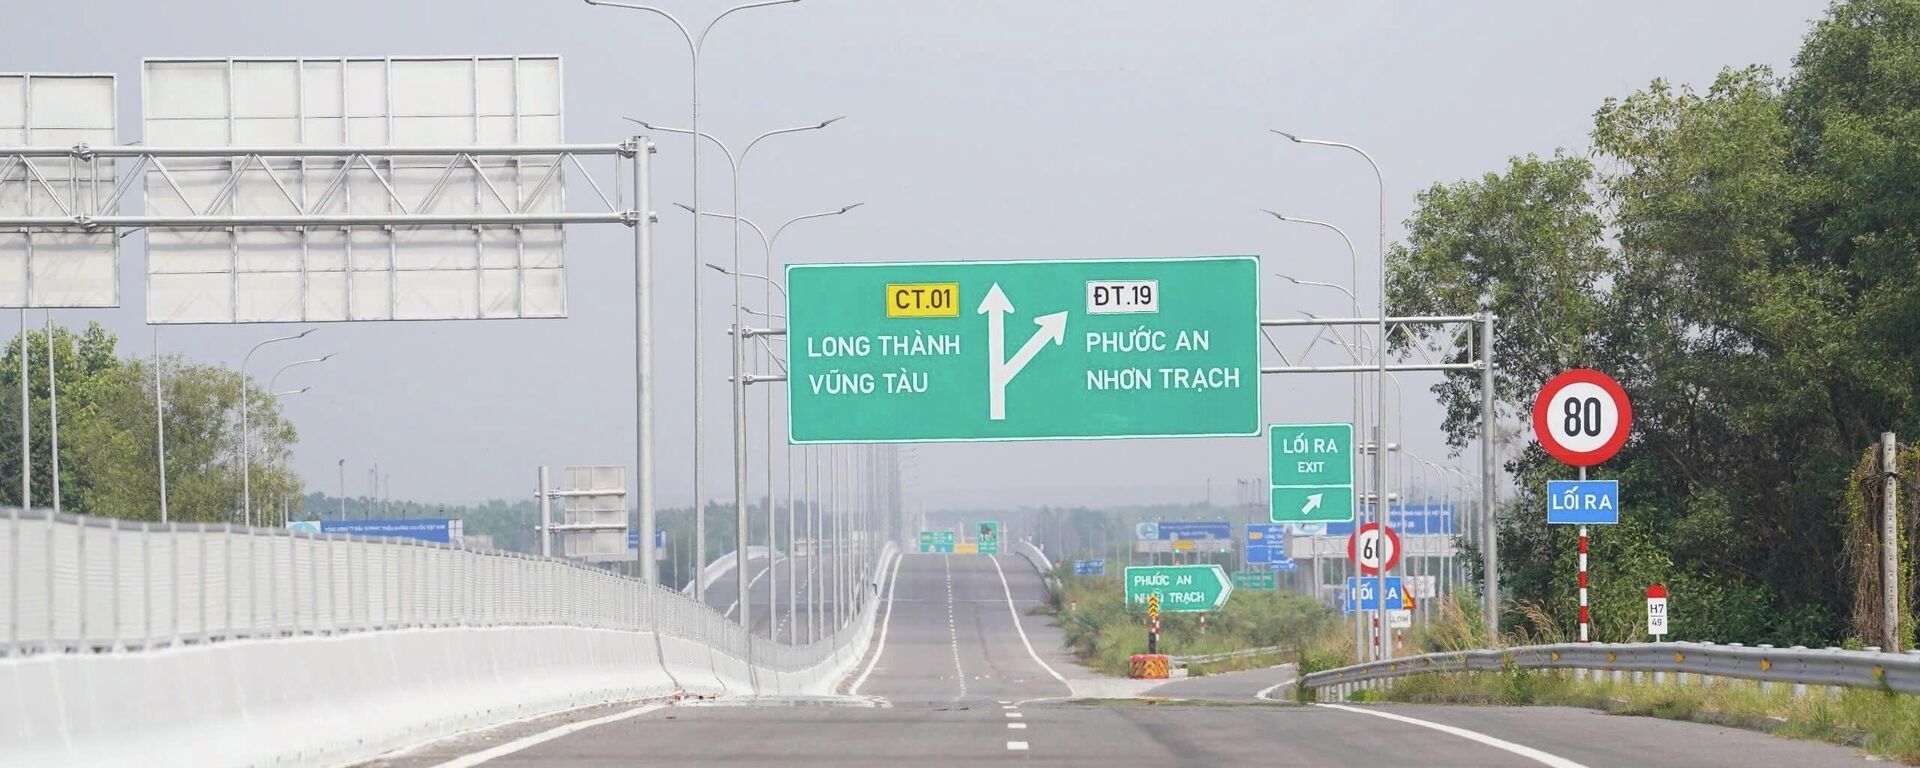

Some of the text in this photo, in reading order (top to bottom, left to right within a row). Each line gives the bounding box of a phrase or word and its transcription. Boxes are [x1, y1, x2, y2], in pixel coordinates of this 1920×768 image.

[895, 288, 952, 310] CT.01
[1094, 285, 1152, 307] ĐT.19
[808, 329, 960, 358] LONG THÀNH
[1086, 324, 1209, 353] PHƯỚC AN
[809, 366, 929, 395] VŨNG TÀU
[1087, 367, 1239, 393] NHƠN TRẠCH
[1563, 397, 1602, 437] 80
[1283, 433, 1338, 454] LỐI RA
[1298, 461, 1325, 473] EXIT
[1553, 486, 1612, 510] LỐI RA
[1134, 572, 1192, 586] PHƯỚC AN
[1169, 592, 1205, 605] TRẠCH
[1650, 604, 1664, 614] H7
[1651, 618, 1662, 627] 49
